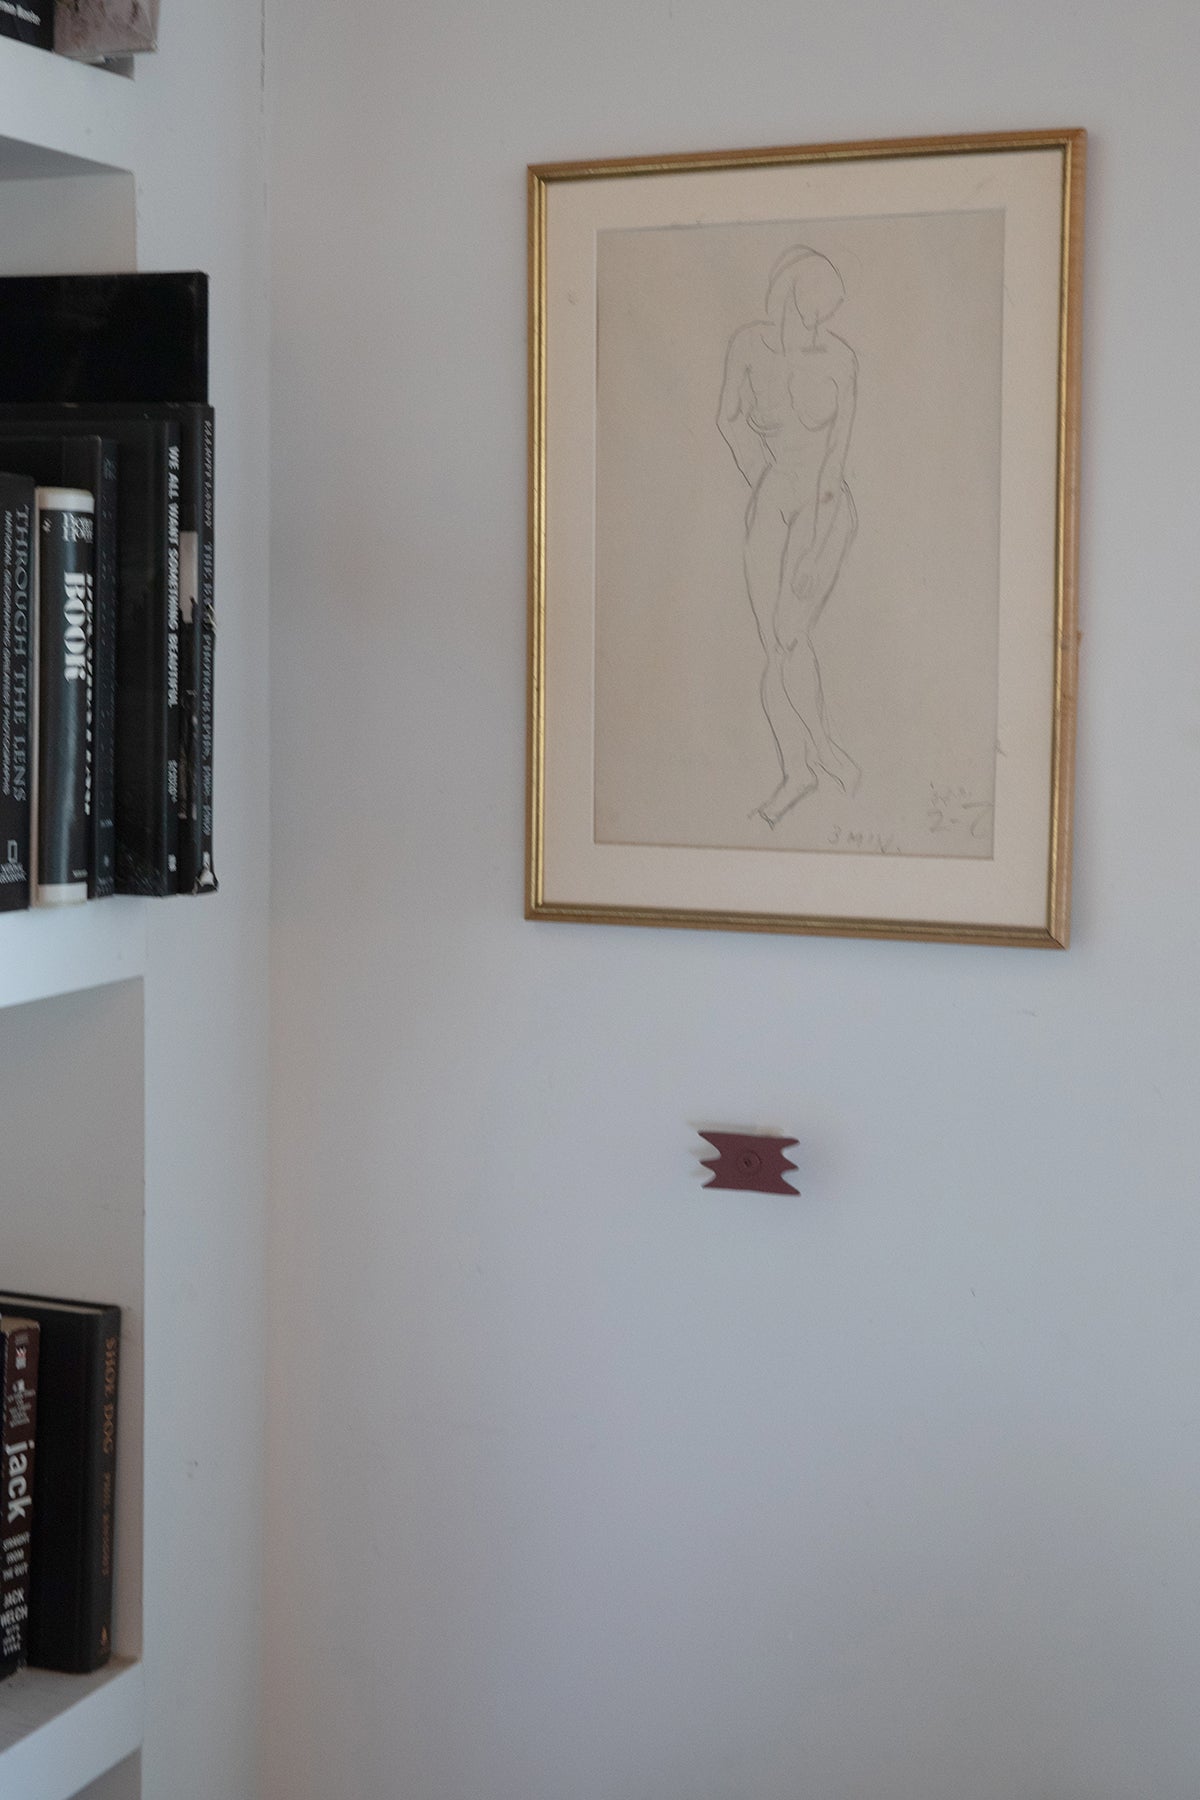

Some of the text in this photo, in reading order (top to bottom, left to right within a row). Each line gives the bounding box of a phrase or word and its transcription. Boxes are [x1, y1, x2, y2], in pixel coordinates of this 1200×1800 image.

[64, 570, 87, 683] BOOK
[168, 445, 180, 708] WE ALL WANT SOMETHING BEAUTIFUL
[12, 504, 29, 802] THROUGH THE LENS
[6, 1439, 35, 1525] jack
[103, 1402, 115, 1454] DOG
